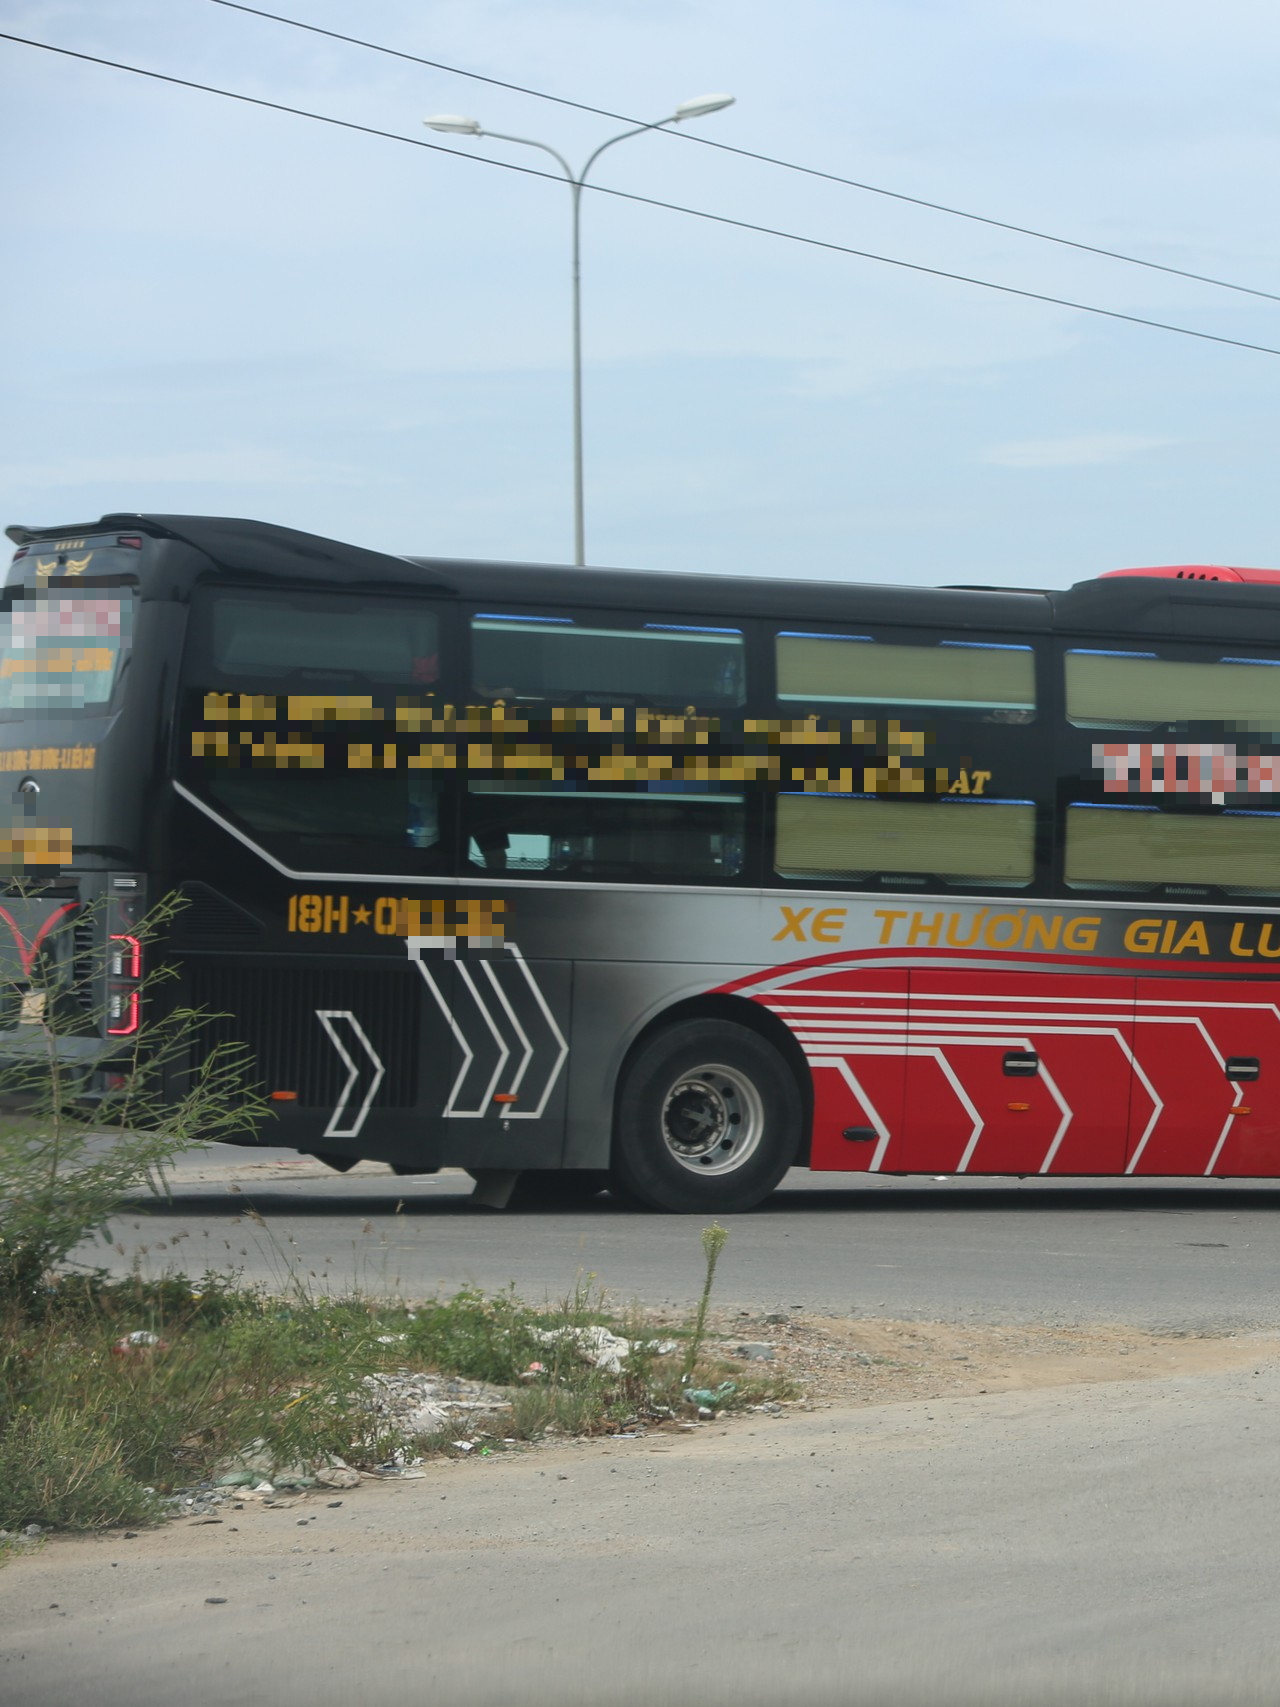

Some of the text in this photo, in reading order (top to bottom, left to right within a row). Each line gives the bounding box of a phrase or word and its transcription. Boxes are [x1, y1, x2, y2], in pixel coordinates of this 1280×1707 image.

[771, 905, 848, 943] XE
[873, 907, 1102, 951] THƯƠNG
[1123, 919, 1211, 955] GIA
